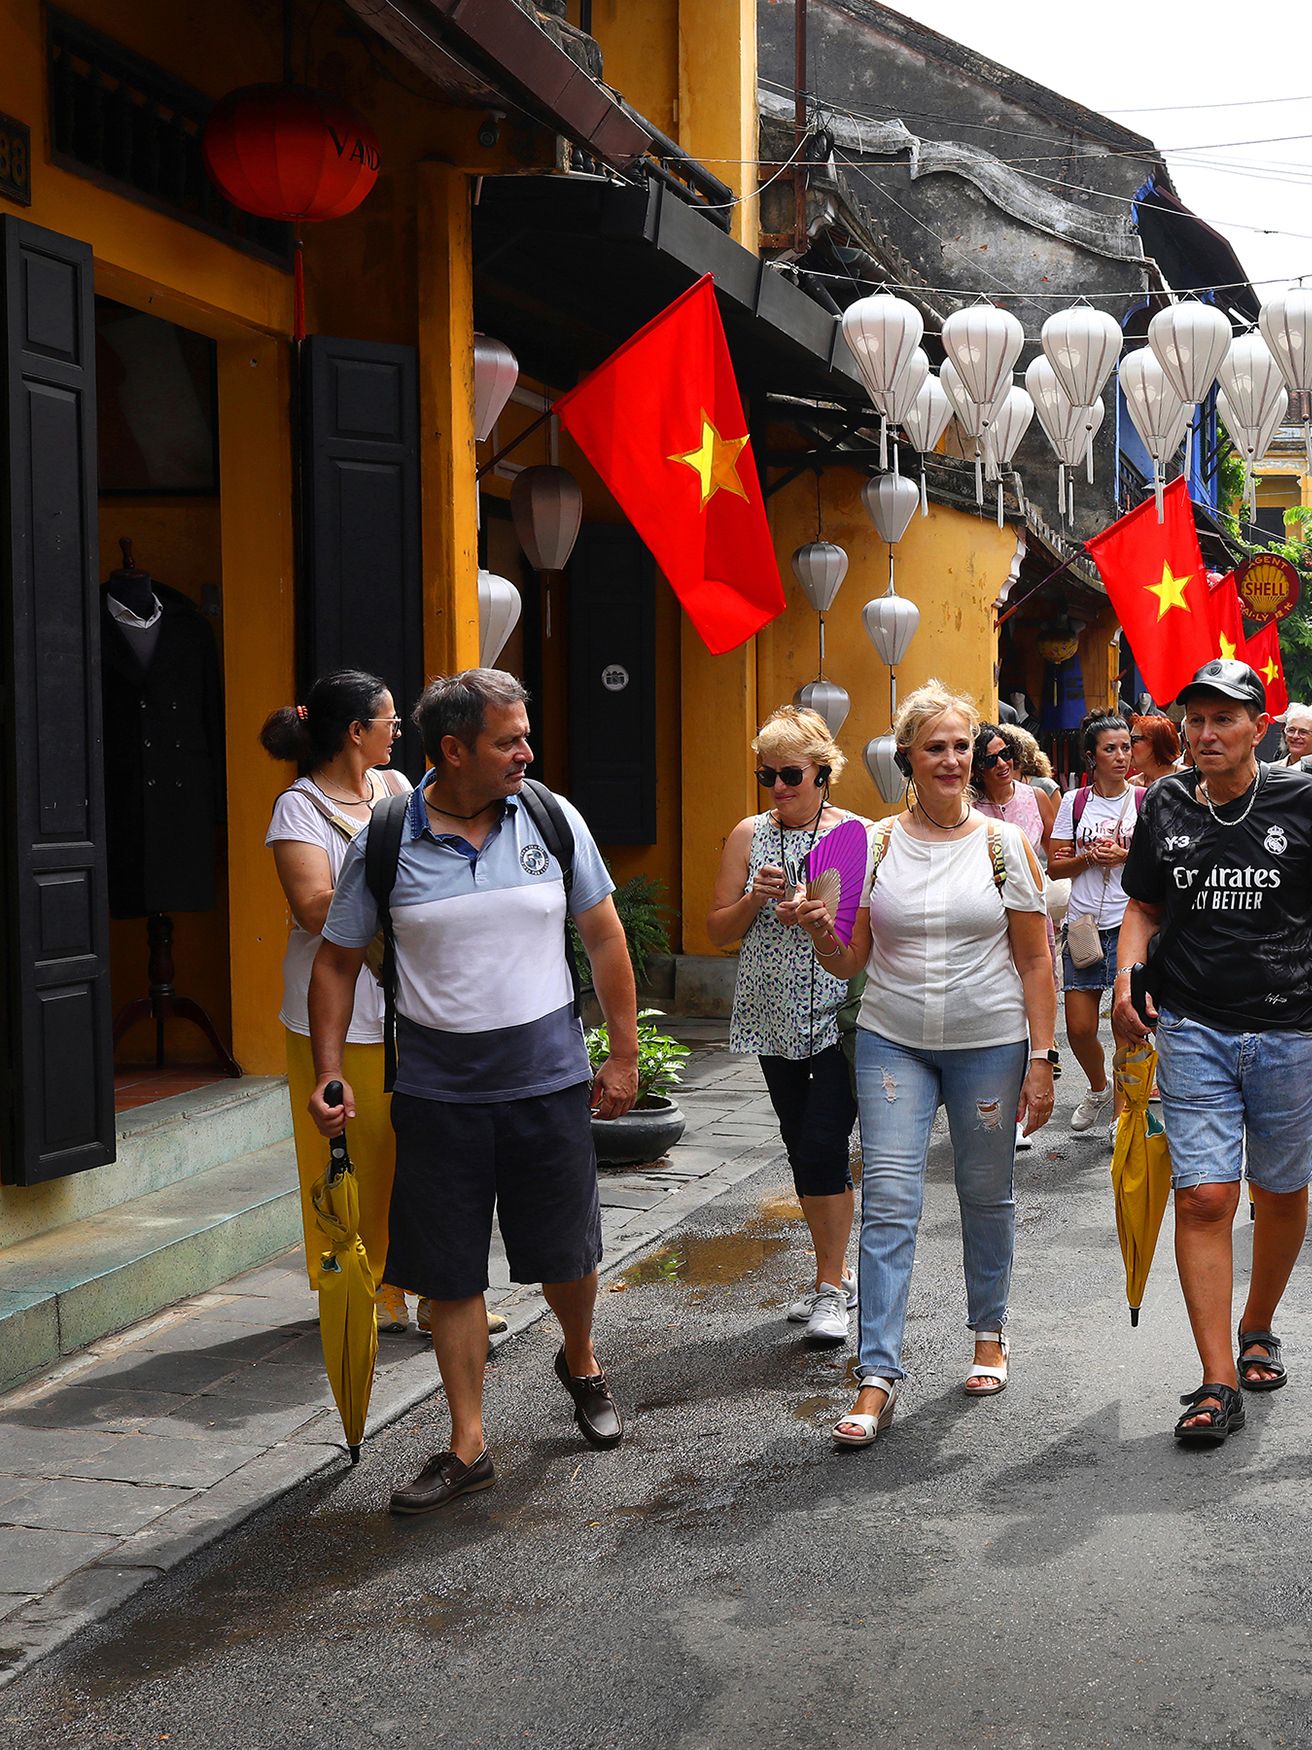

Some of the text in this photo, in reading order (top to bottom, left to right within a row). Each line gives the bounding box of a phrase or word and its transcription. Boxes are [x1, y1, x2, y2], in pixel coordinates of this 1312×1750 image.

[1245, 582, 1286, 596] SHELL
[1164, 835, 1190, 851] Y-3
[1191, 891, 1263, 910] LY BETTER
